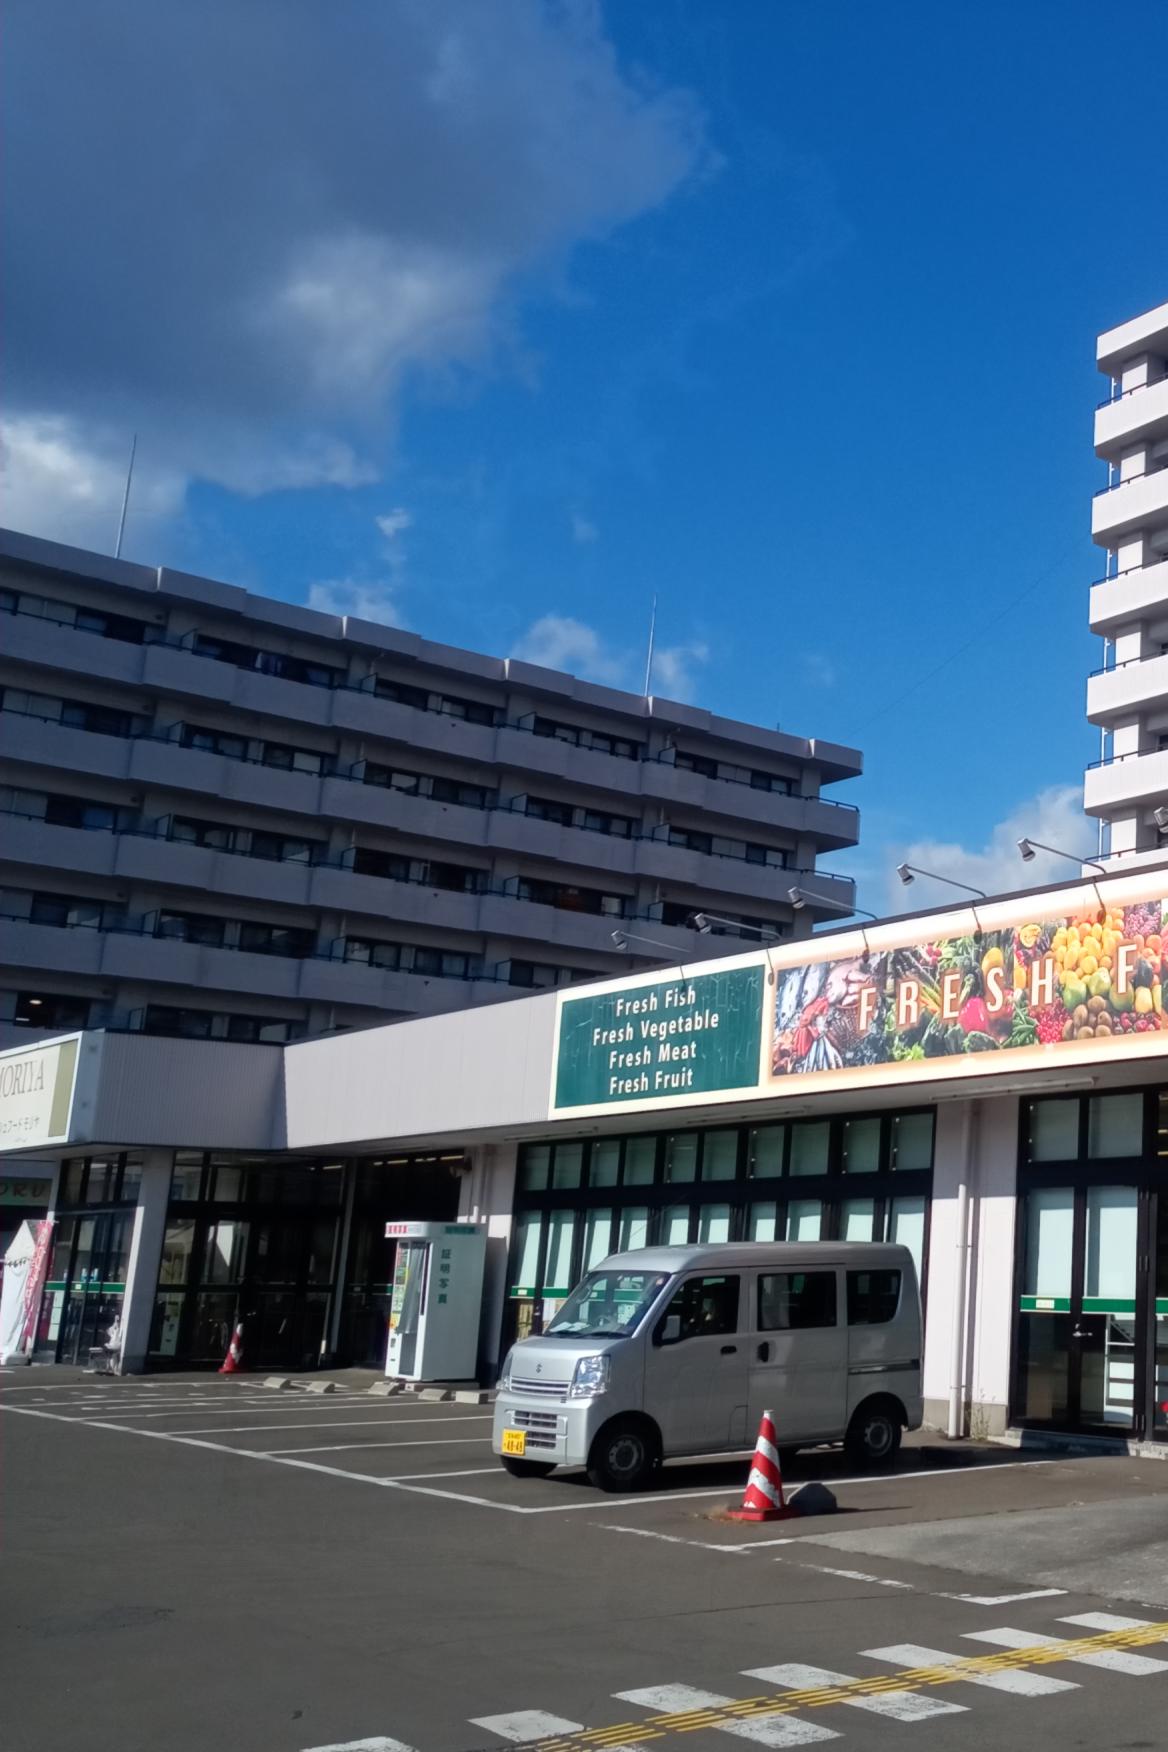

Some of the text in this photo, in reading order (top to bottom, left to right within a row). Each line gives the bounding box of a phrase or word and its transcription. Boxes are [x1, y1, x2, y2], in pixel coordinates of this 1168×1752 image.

[616, 985, 696, 1017] Fresh Fish
[857, 957, 1055, 1031] FRESH
[593, 1009, 719, 1046] Fresh Vegetable
[609, 1041, 697, 1070] Fresh Meat
[609, 1067, 693, 1095] Fresh Fruit
